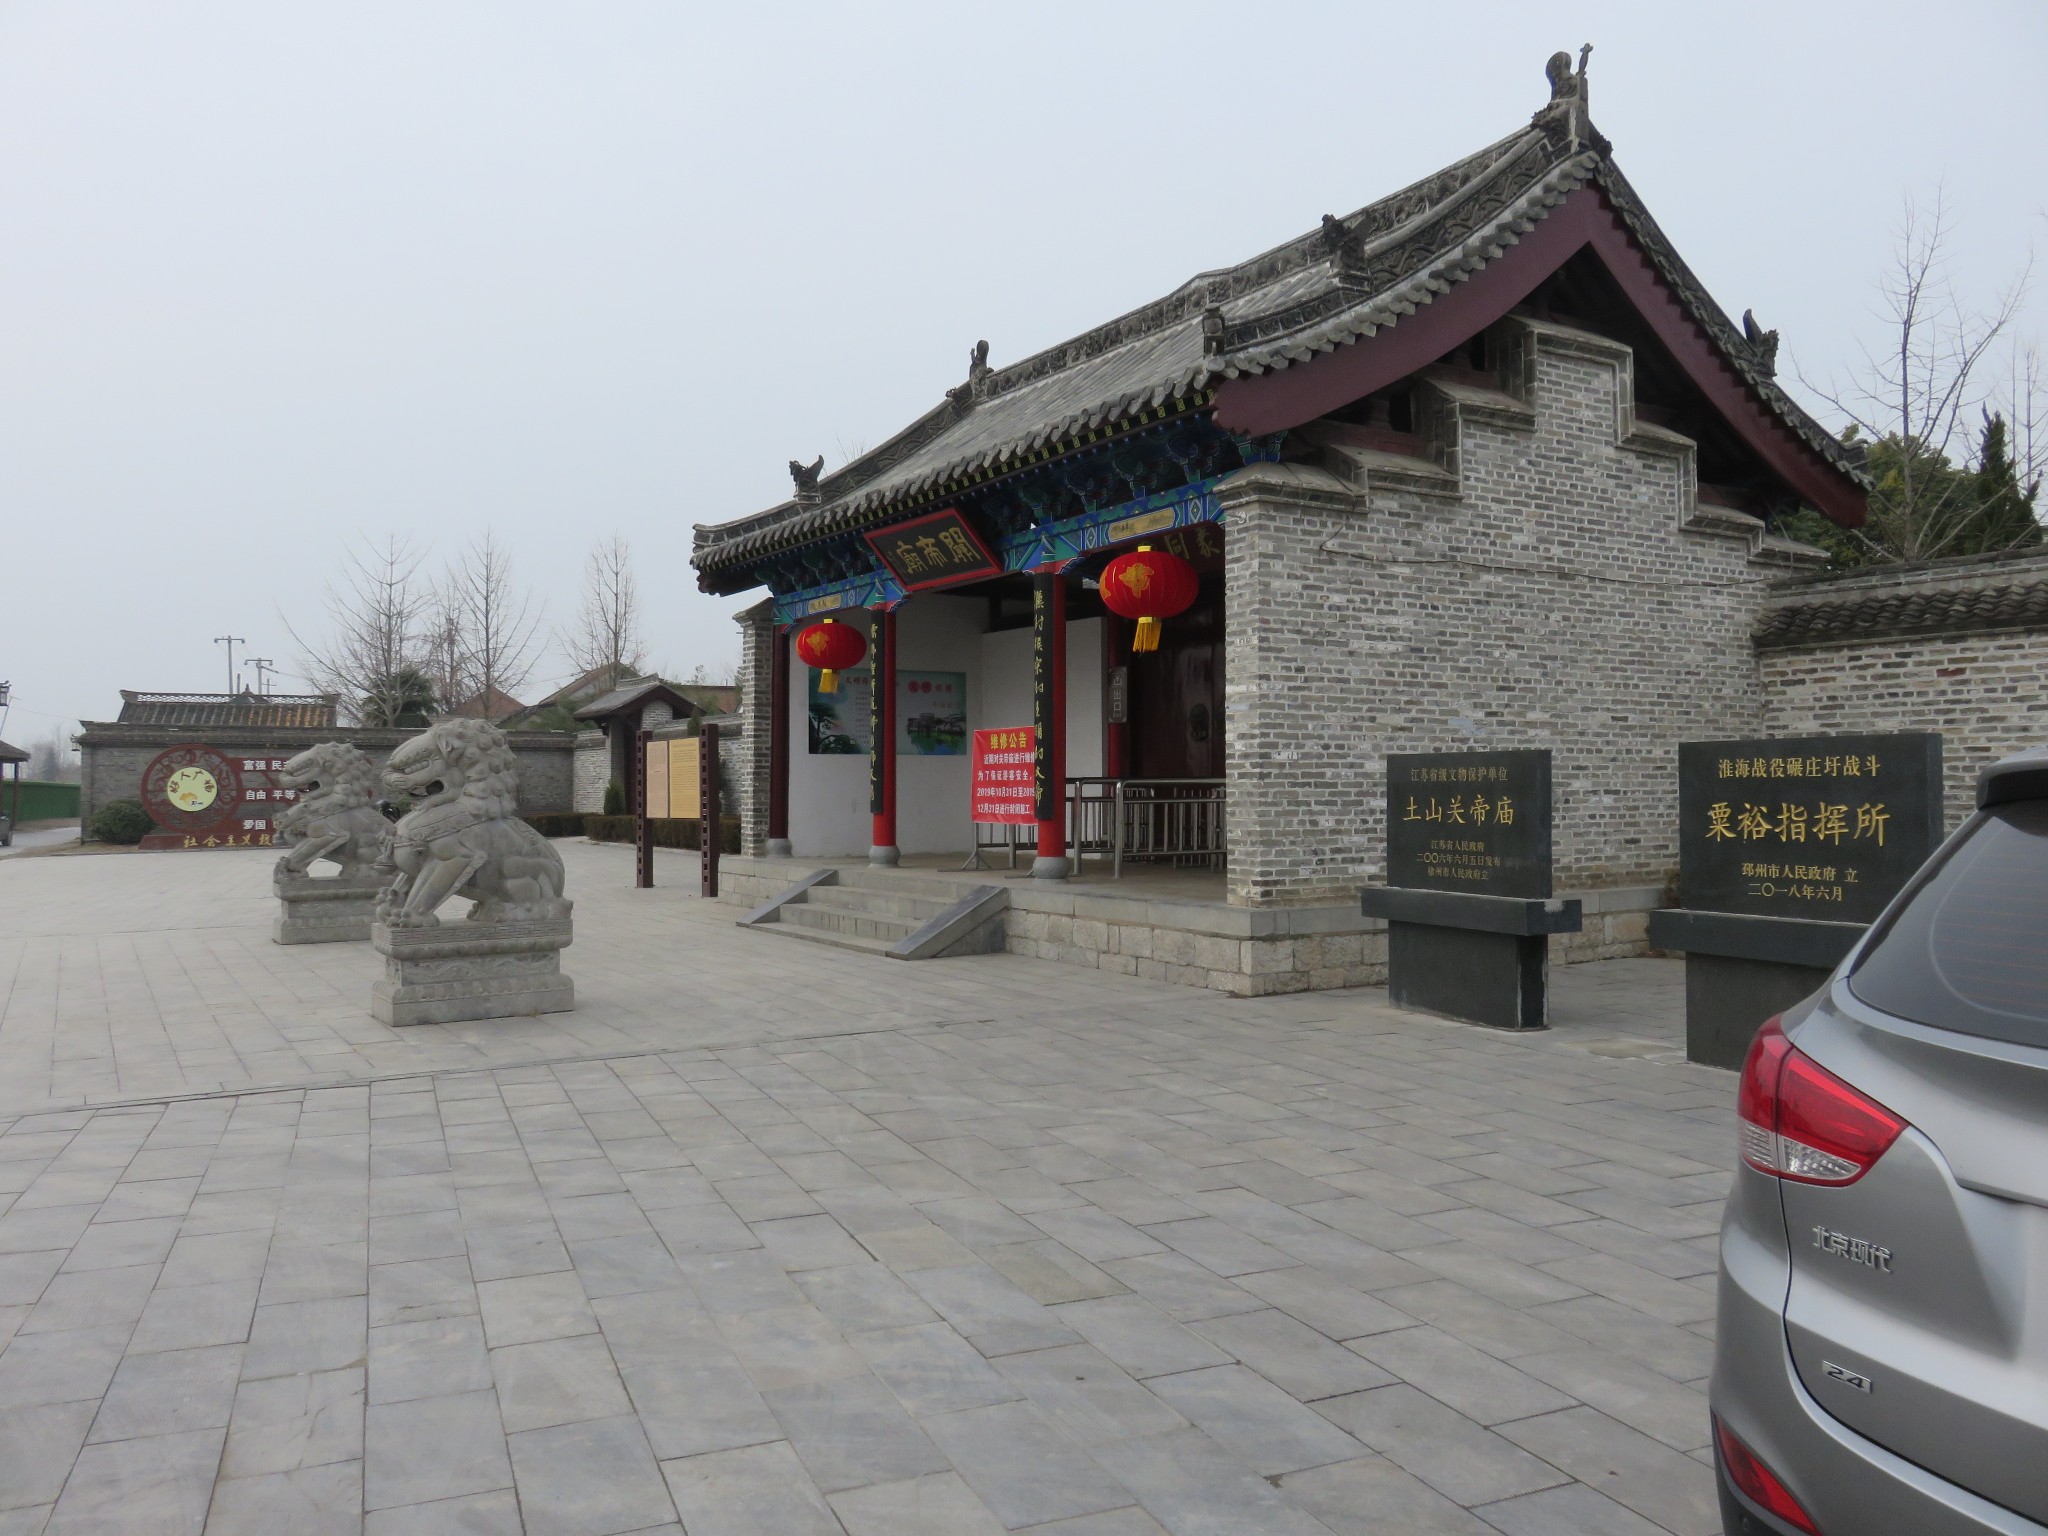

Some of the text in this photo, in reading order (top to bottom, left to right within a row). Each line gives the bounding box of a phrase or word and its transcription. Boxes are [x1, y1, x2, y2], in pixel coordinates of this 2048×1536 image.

[990, 732, 1027, 750] 维修公告
[243, 760, 266, 771] 富强
[1411, 767, 1508, 782] 江苏省级文物保护单位
[1718, 755, 1881, 778] 淮海战役碾庄圩战斗
[245, 790, 296, 801] 自由 平等
[1403, 794, 1515, 826] 土山关帝庙
[243, 820, 266, 830] 爱国
[1705, 802, 1891, 847] 粟裕指挥所
[1430, 840, 1485, 852] 江苏省人民政府
[1741, 863, 1859, 883] 邳州市人民政府 立
[1812, 1225, 1893, 1273] 北京现代
